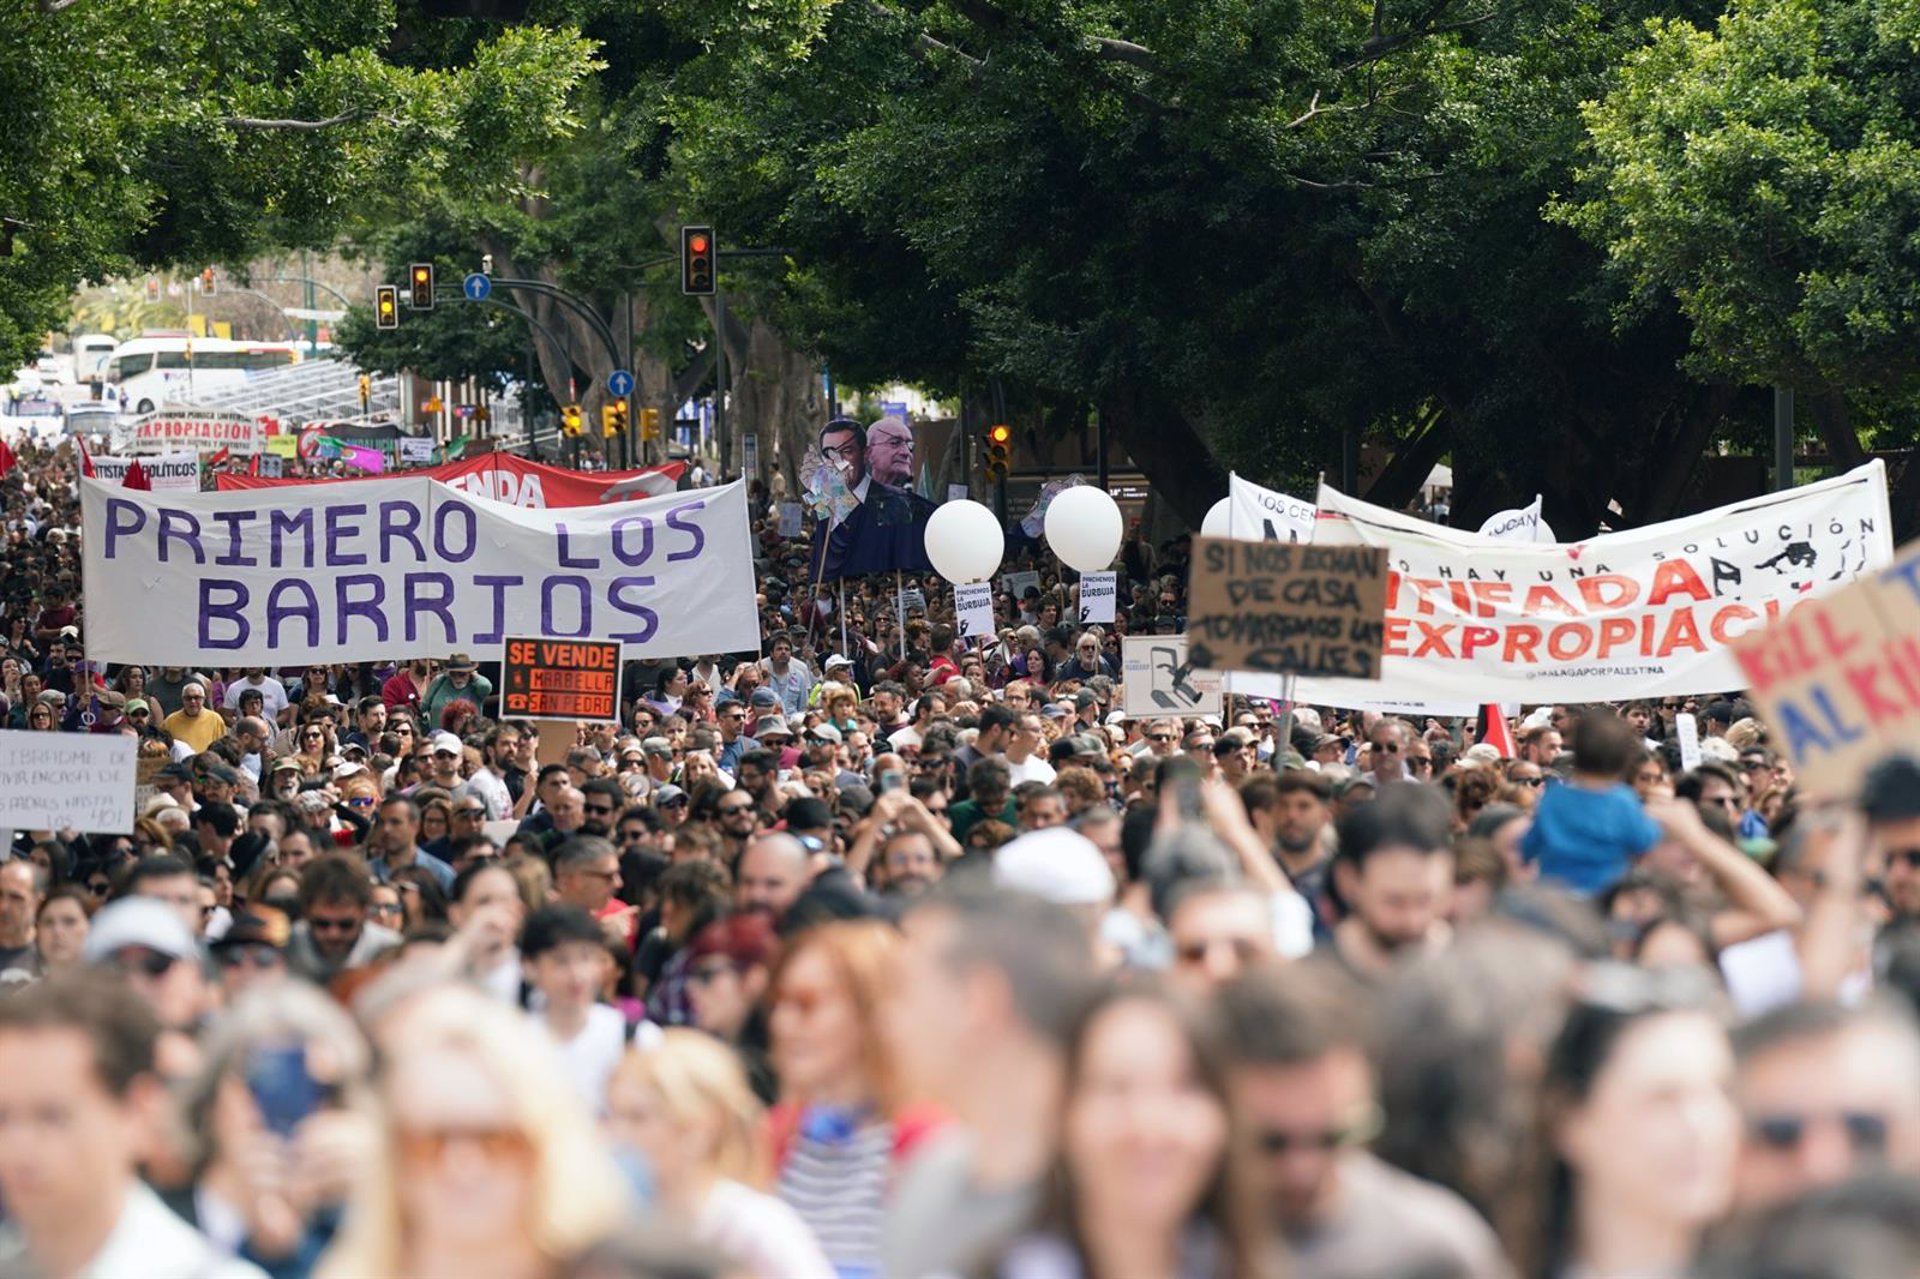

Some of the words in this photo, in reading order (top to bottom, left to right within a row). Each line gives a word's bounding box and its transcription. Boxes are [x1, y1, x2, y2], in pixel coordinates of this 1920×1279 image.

[105, 497, 477, 567] PRIMERO
[555, 501, 705, 569] LOS
[1439, 565, 1506, 581] HAY
[1538, 562, 1611, 583] UNA
[1652, 517, 1875, 561] SOLUCIÓN
[1206, 543, 1234, 575] SI
[1245, 544, 1291, 575] NOS
[1301, 545, 1378, 580] ECHAN
[198, 572, 659, 648] BARRIOS
[1227, 578, 1275, 606] DE
[1283, 577, 1361, 611] CASA
[509, 642, 536, 665] SE
[542, 643, 616, 669] VENDE
[534, 670, 613, 691] MARBELLA
[530, 693, 558, 710] SAN
[563, 694, 612, 714] PEDRO
[1776, 683, 1864, 766] AL
